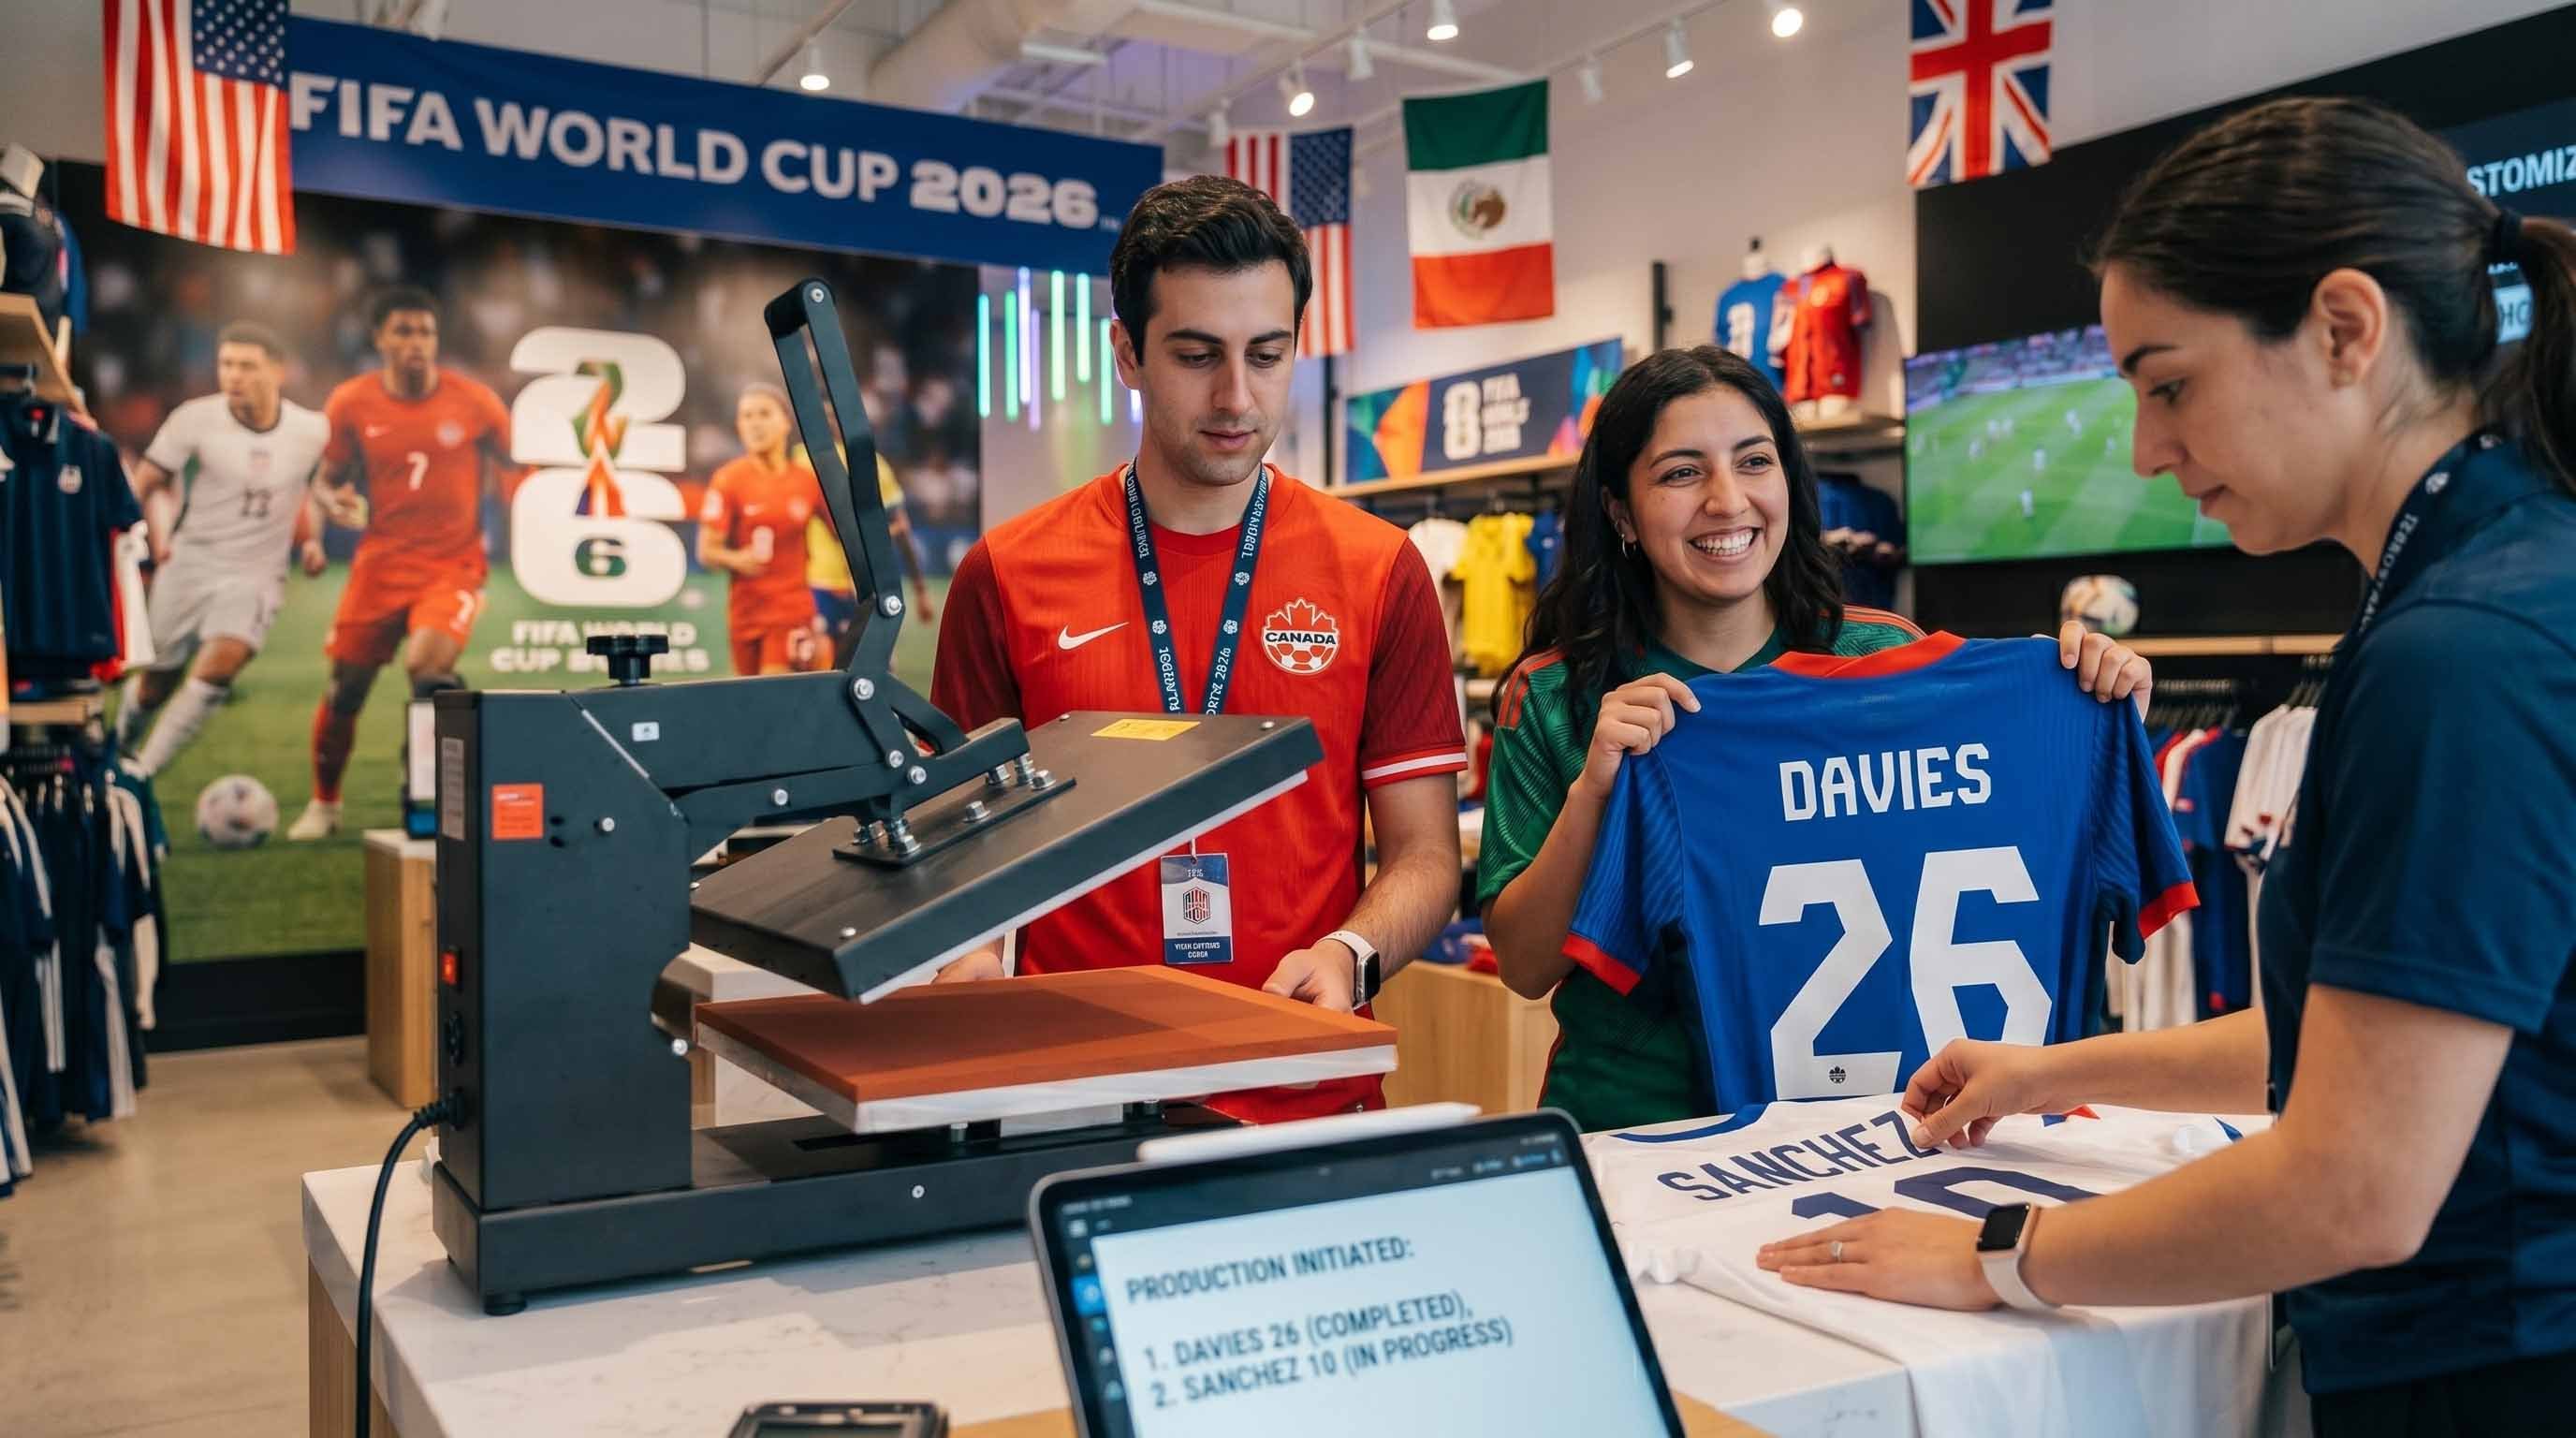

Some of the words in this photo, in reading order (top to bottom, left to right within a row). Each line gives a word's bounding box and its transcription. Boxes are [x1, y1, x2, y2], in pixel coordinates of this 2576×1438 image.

[289, 71, 463, 151] FIFA
[474, 97, 748, 184] WORLD
[761, 139, 899, 202] CUP
[910, 159, 1099, 229] 2026
[407, 452, 428, 491] 7
[1266, 632, 1336, 645] CANADA
[1779, 743, 1991, 821] DAVIES
[1759, 846, 2052, 1100] 26
[1657, 1110, 1941, 1201] SANCHEZ
[1125, 1254, 1286, 1303] PRODUCTION
[1291, 1236, 1414, 1276] INITIATED:
[1144, 1346, 1168, 1372] 1.
[1173, 1327, 1264, 1366] DAVIES
[1268, 1321, 1300, 1349] 26
[1306, 1289, 1473, 1346] (COMPLETED),
[1150, 1381, 1178, 1408] 2.
[1183, 1356, 1302, 1401] SANCHEZ
[1307, 1349, 1337, 1377] 10
[1343, 1343, 1379, 1380] (IN
[1382, 1315, 1514, 1364] PROGRESS)
